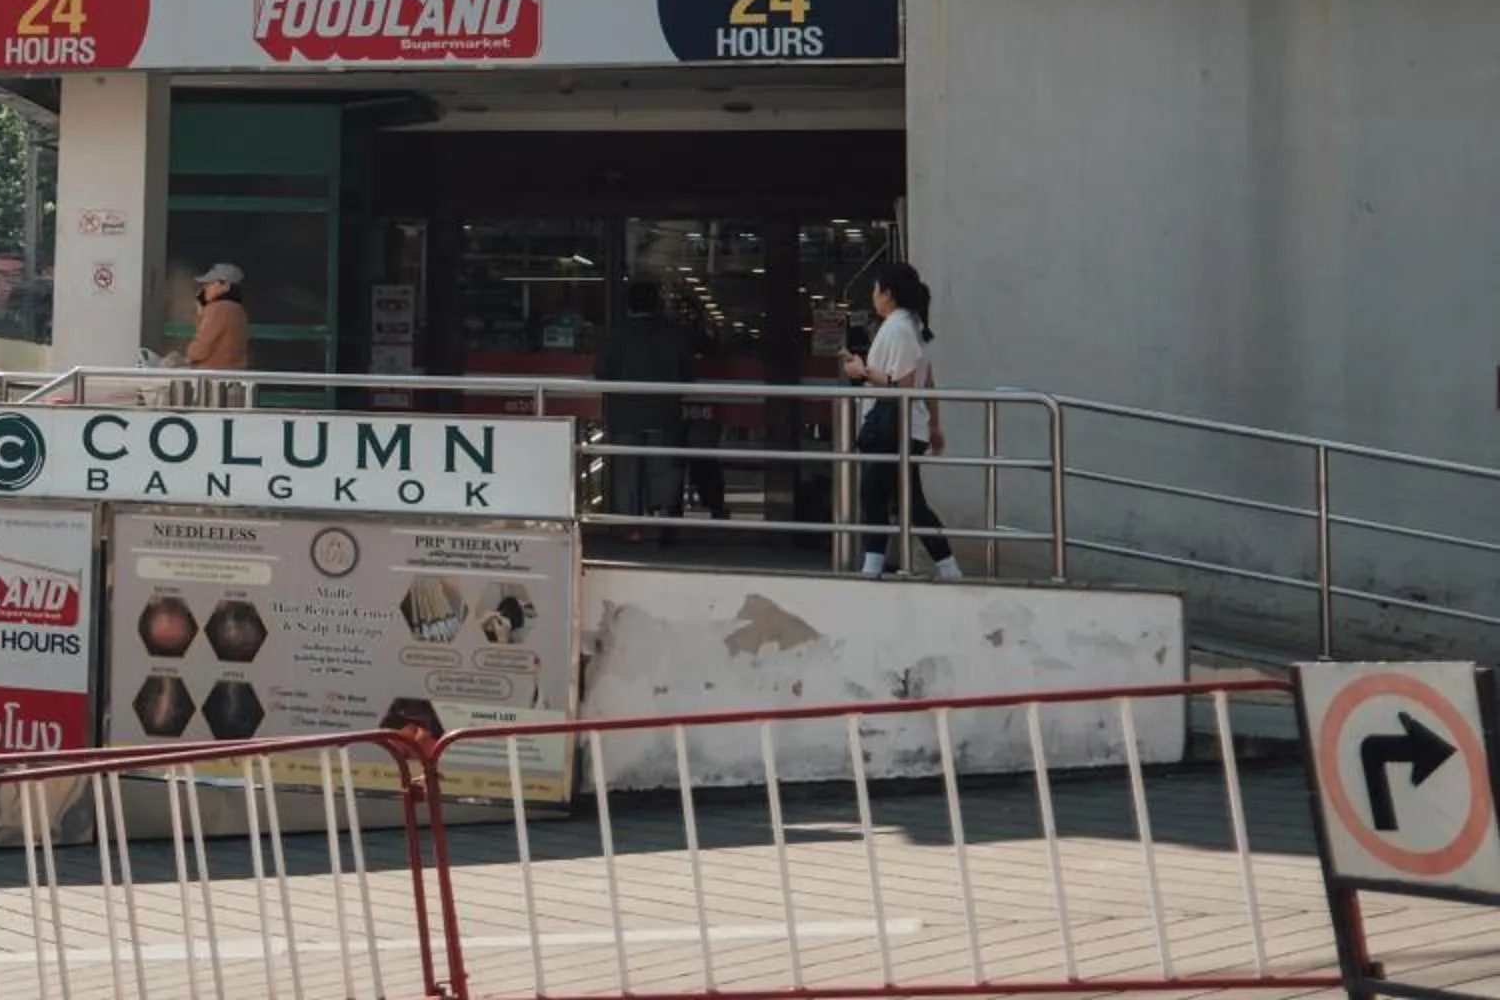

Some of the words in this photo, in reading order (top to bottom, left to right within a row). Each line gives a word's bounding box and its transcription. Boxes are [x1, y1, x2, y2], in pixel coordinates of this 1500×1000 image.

[4, 36, 96, 66] HOURS
[400, 37, 512, 51] Supermarket
[716, 26, 824, 58] HOURS
[82, 414, 496, 474] COLUMN
[87, 468, 490, 507] BANGKOK
[1, 629, 81, 655] HOURS
